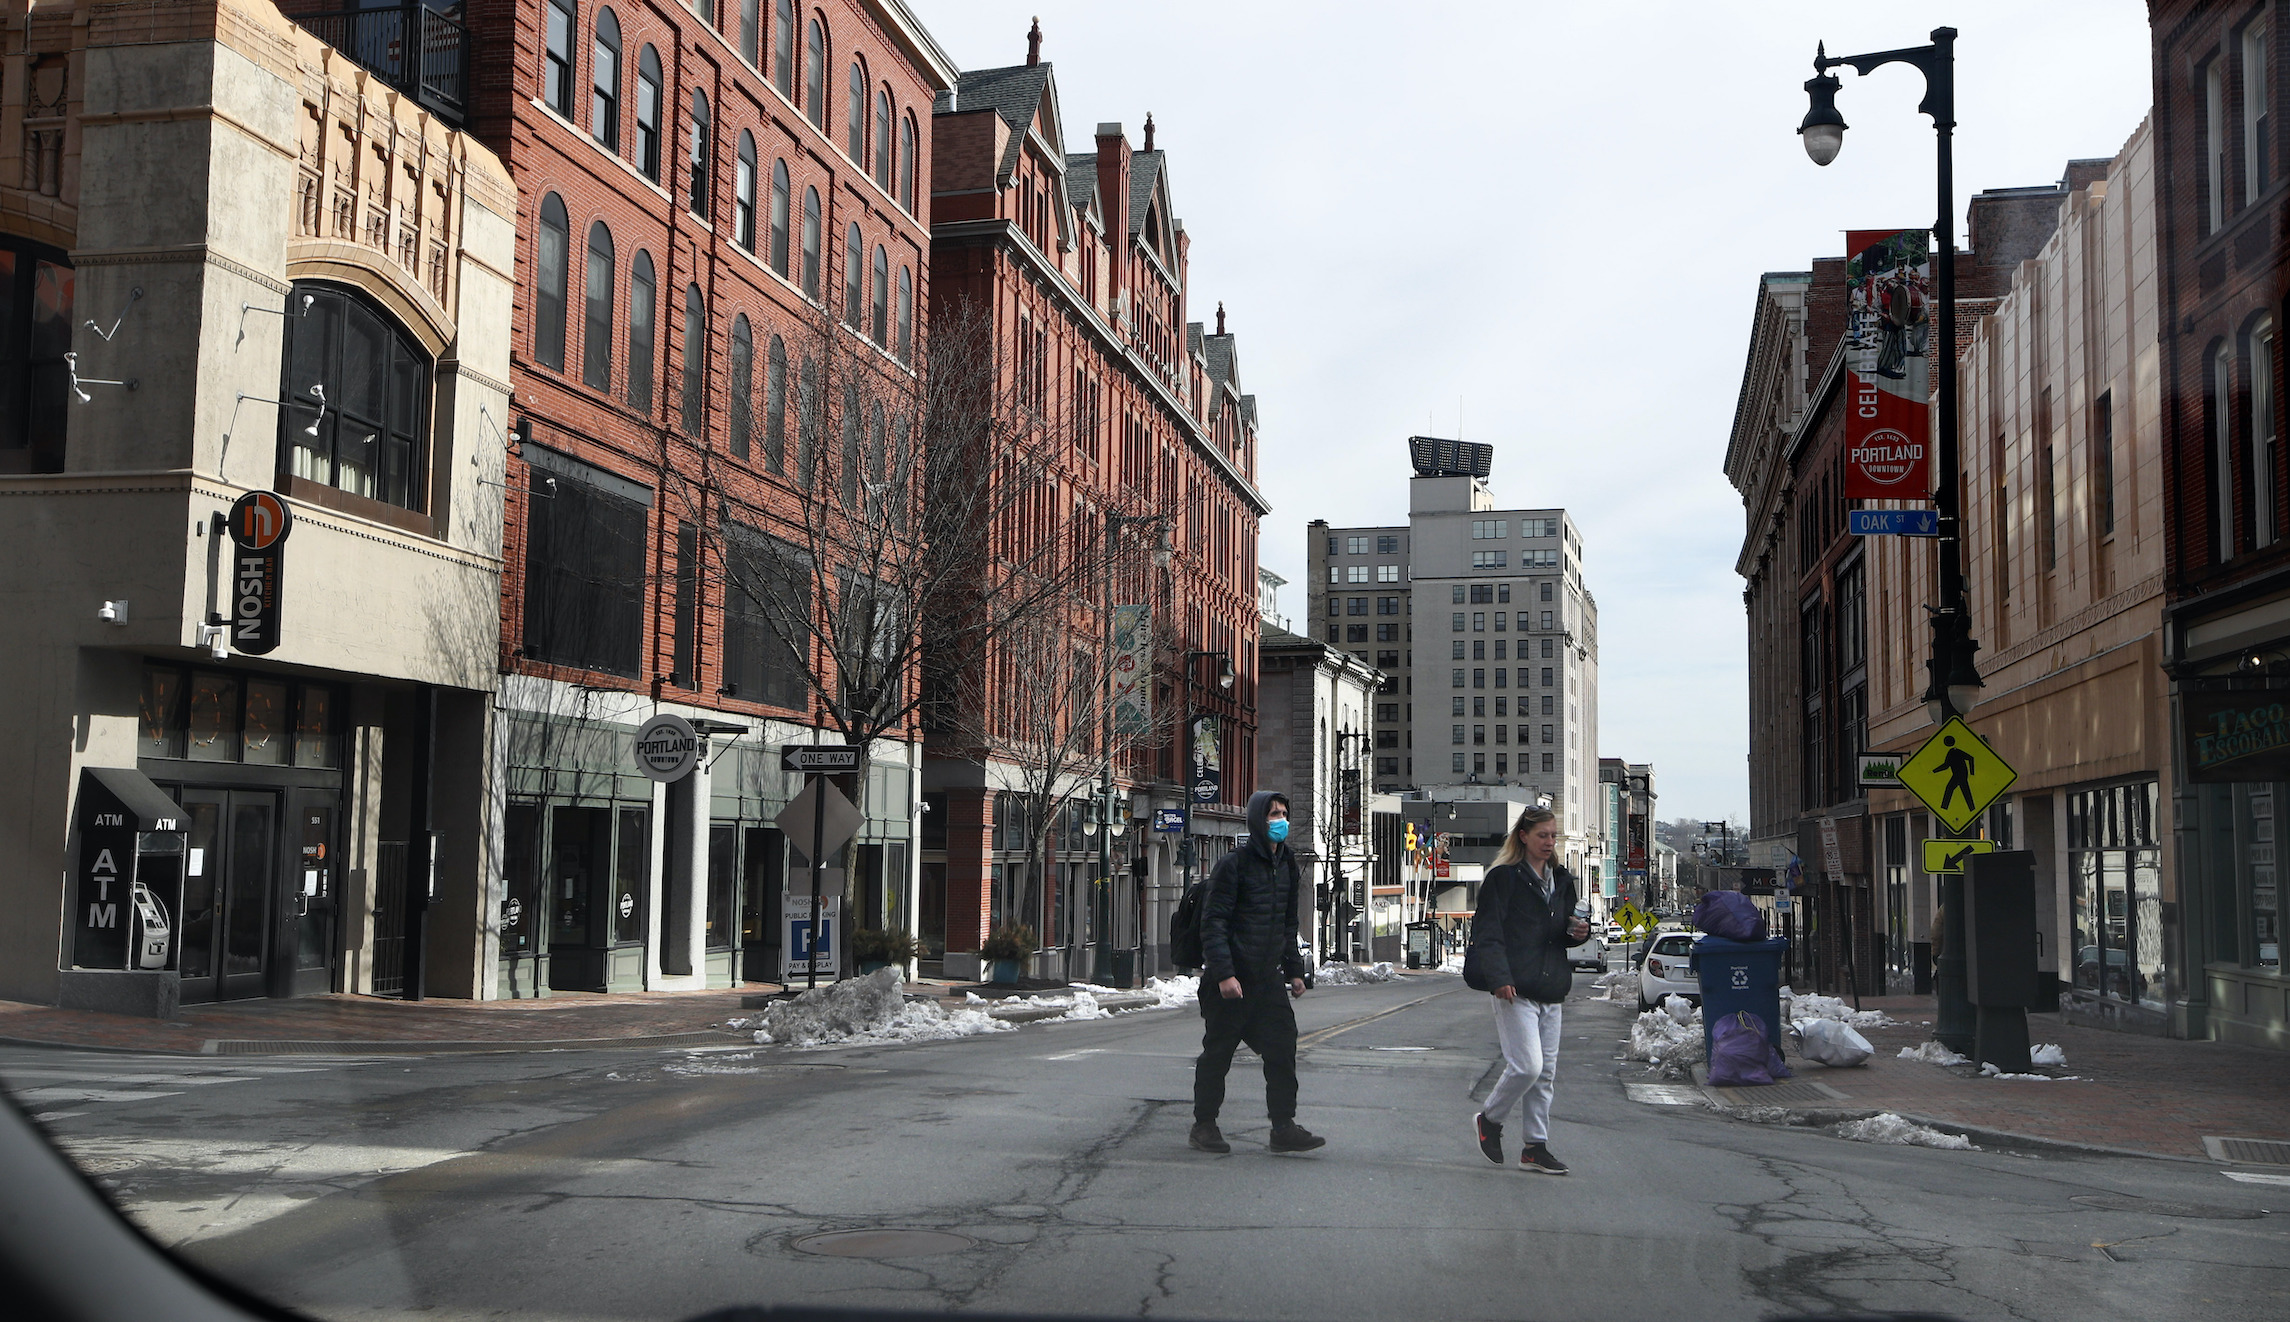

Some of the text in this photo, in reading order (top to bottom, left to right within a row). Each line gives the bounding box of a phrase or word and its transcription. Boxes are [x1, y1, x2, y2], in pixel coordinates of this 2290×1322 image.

[1858, 311, 1879, 418] CELEBRATE
[1851, 444, 1923, 463] PORTLAND
[1868, 464, 1905, 473] DOWNTOWN
[1860, 515, 1905, 530] OAK ST
[237, 557, 265, 640] NOSH
[264, 576, 272, 608] KITCHEN
[2208, 703, 2284, 739] TACO
[637, 738, 694, 754] PORTLAND
[2194, 721, 2290, 766] ESCOBAR
[800, 753, 853, 763] ONE WAY
[94, 814, 123, 827] ATM
[155, 818, 177, 831] ATM
[87, 848, 119, 929] ATM
[785, 911, 836, 920] PUBLIC PKING
